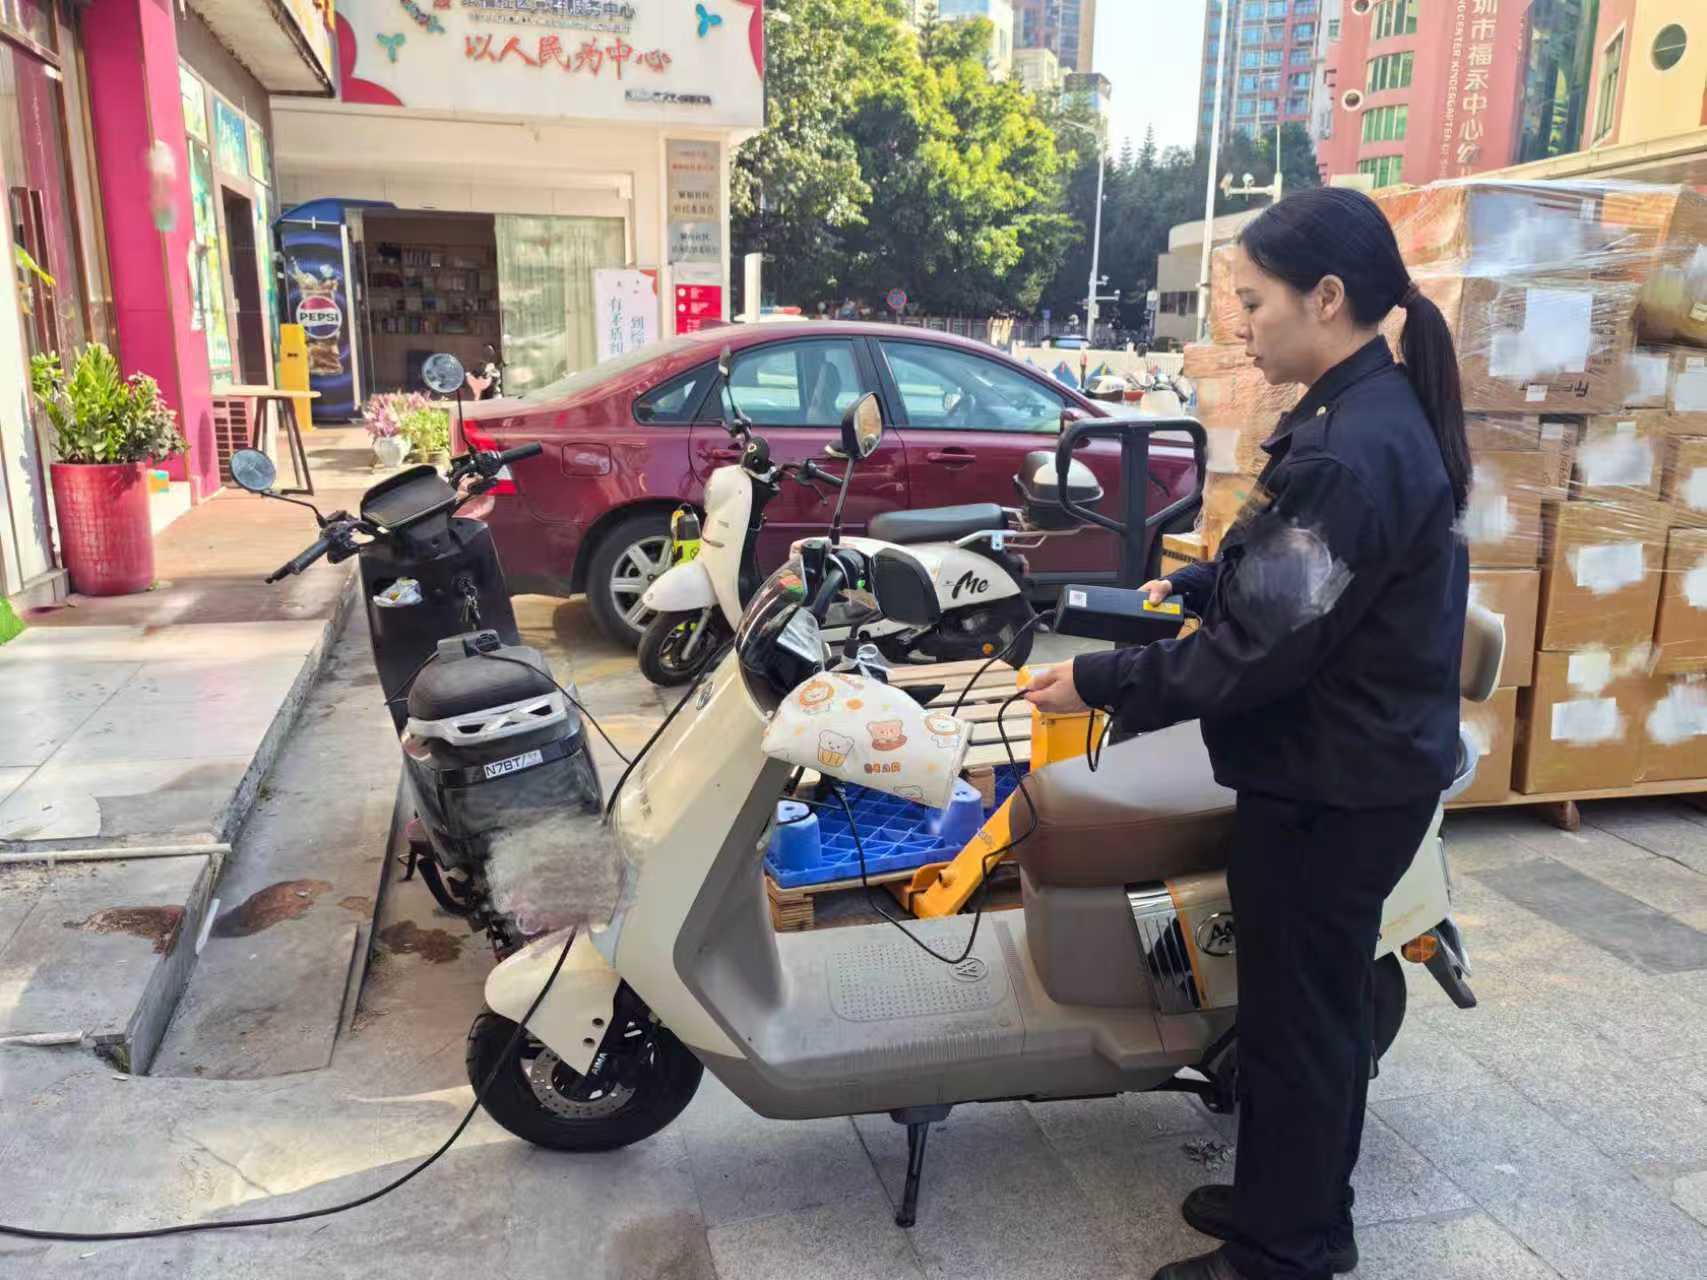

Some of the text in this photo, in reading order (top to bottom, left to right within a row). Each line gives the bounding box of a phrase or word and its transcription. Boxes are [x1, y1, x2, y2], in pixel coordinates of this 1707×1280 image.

[1453, 14, 1465, 57] CENTER
[464, 33, 673, 80] 以人民为中心
[1443, 61, 1460, 142] KINDERGARTEN
[300, 312, 339, 322] PEPSI
[952, 570, 990, 600] Me
[591, 1053, 608, 1076] AIMA
